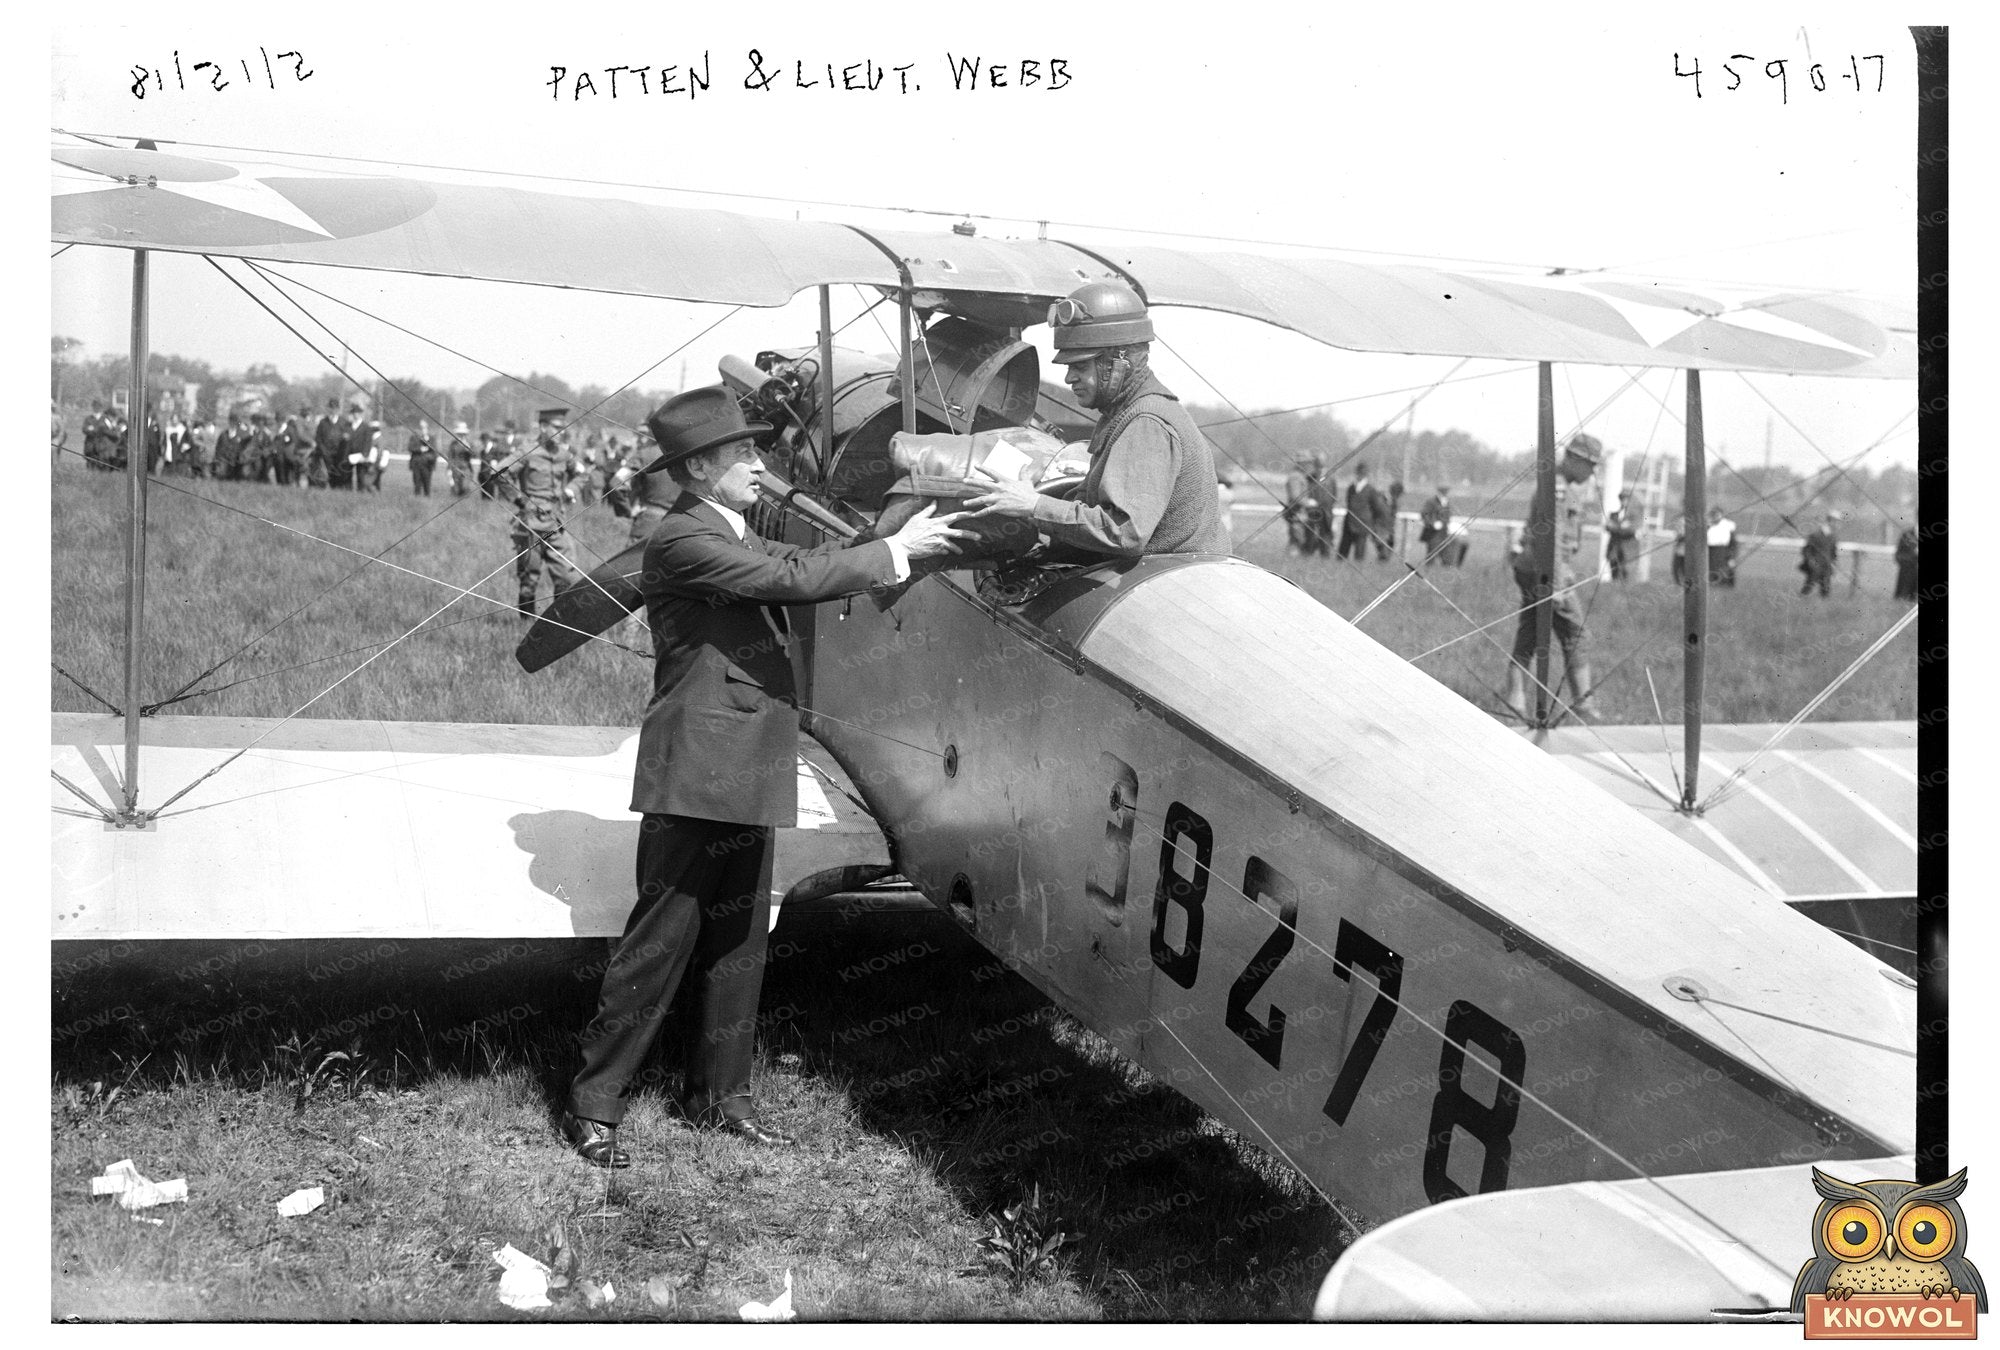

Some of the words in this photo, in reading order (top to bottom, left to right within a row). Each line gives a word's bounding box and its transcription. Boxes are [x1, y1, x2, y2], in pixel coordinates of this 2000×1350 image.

[548, 50, 710, 101] PATTEN
[746, 50, 781, 91] &
[798, 61, 921, 94] LIEUT.
[949, 52, 1072, 91] WEBB
